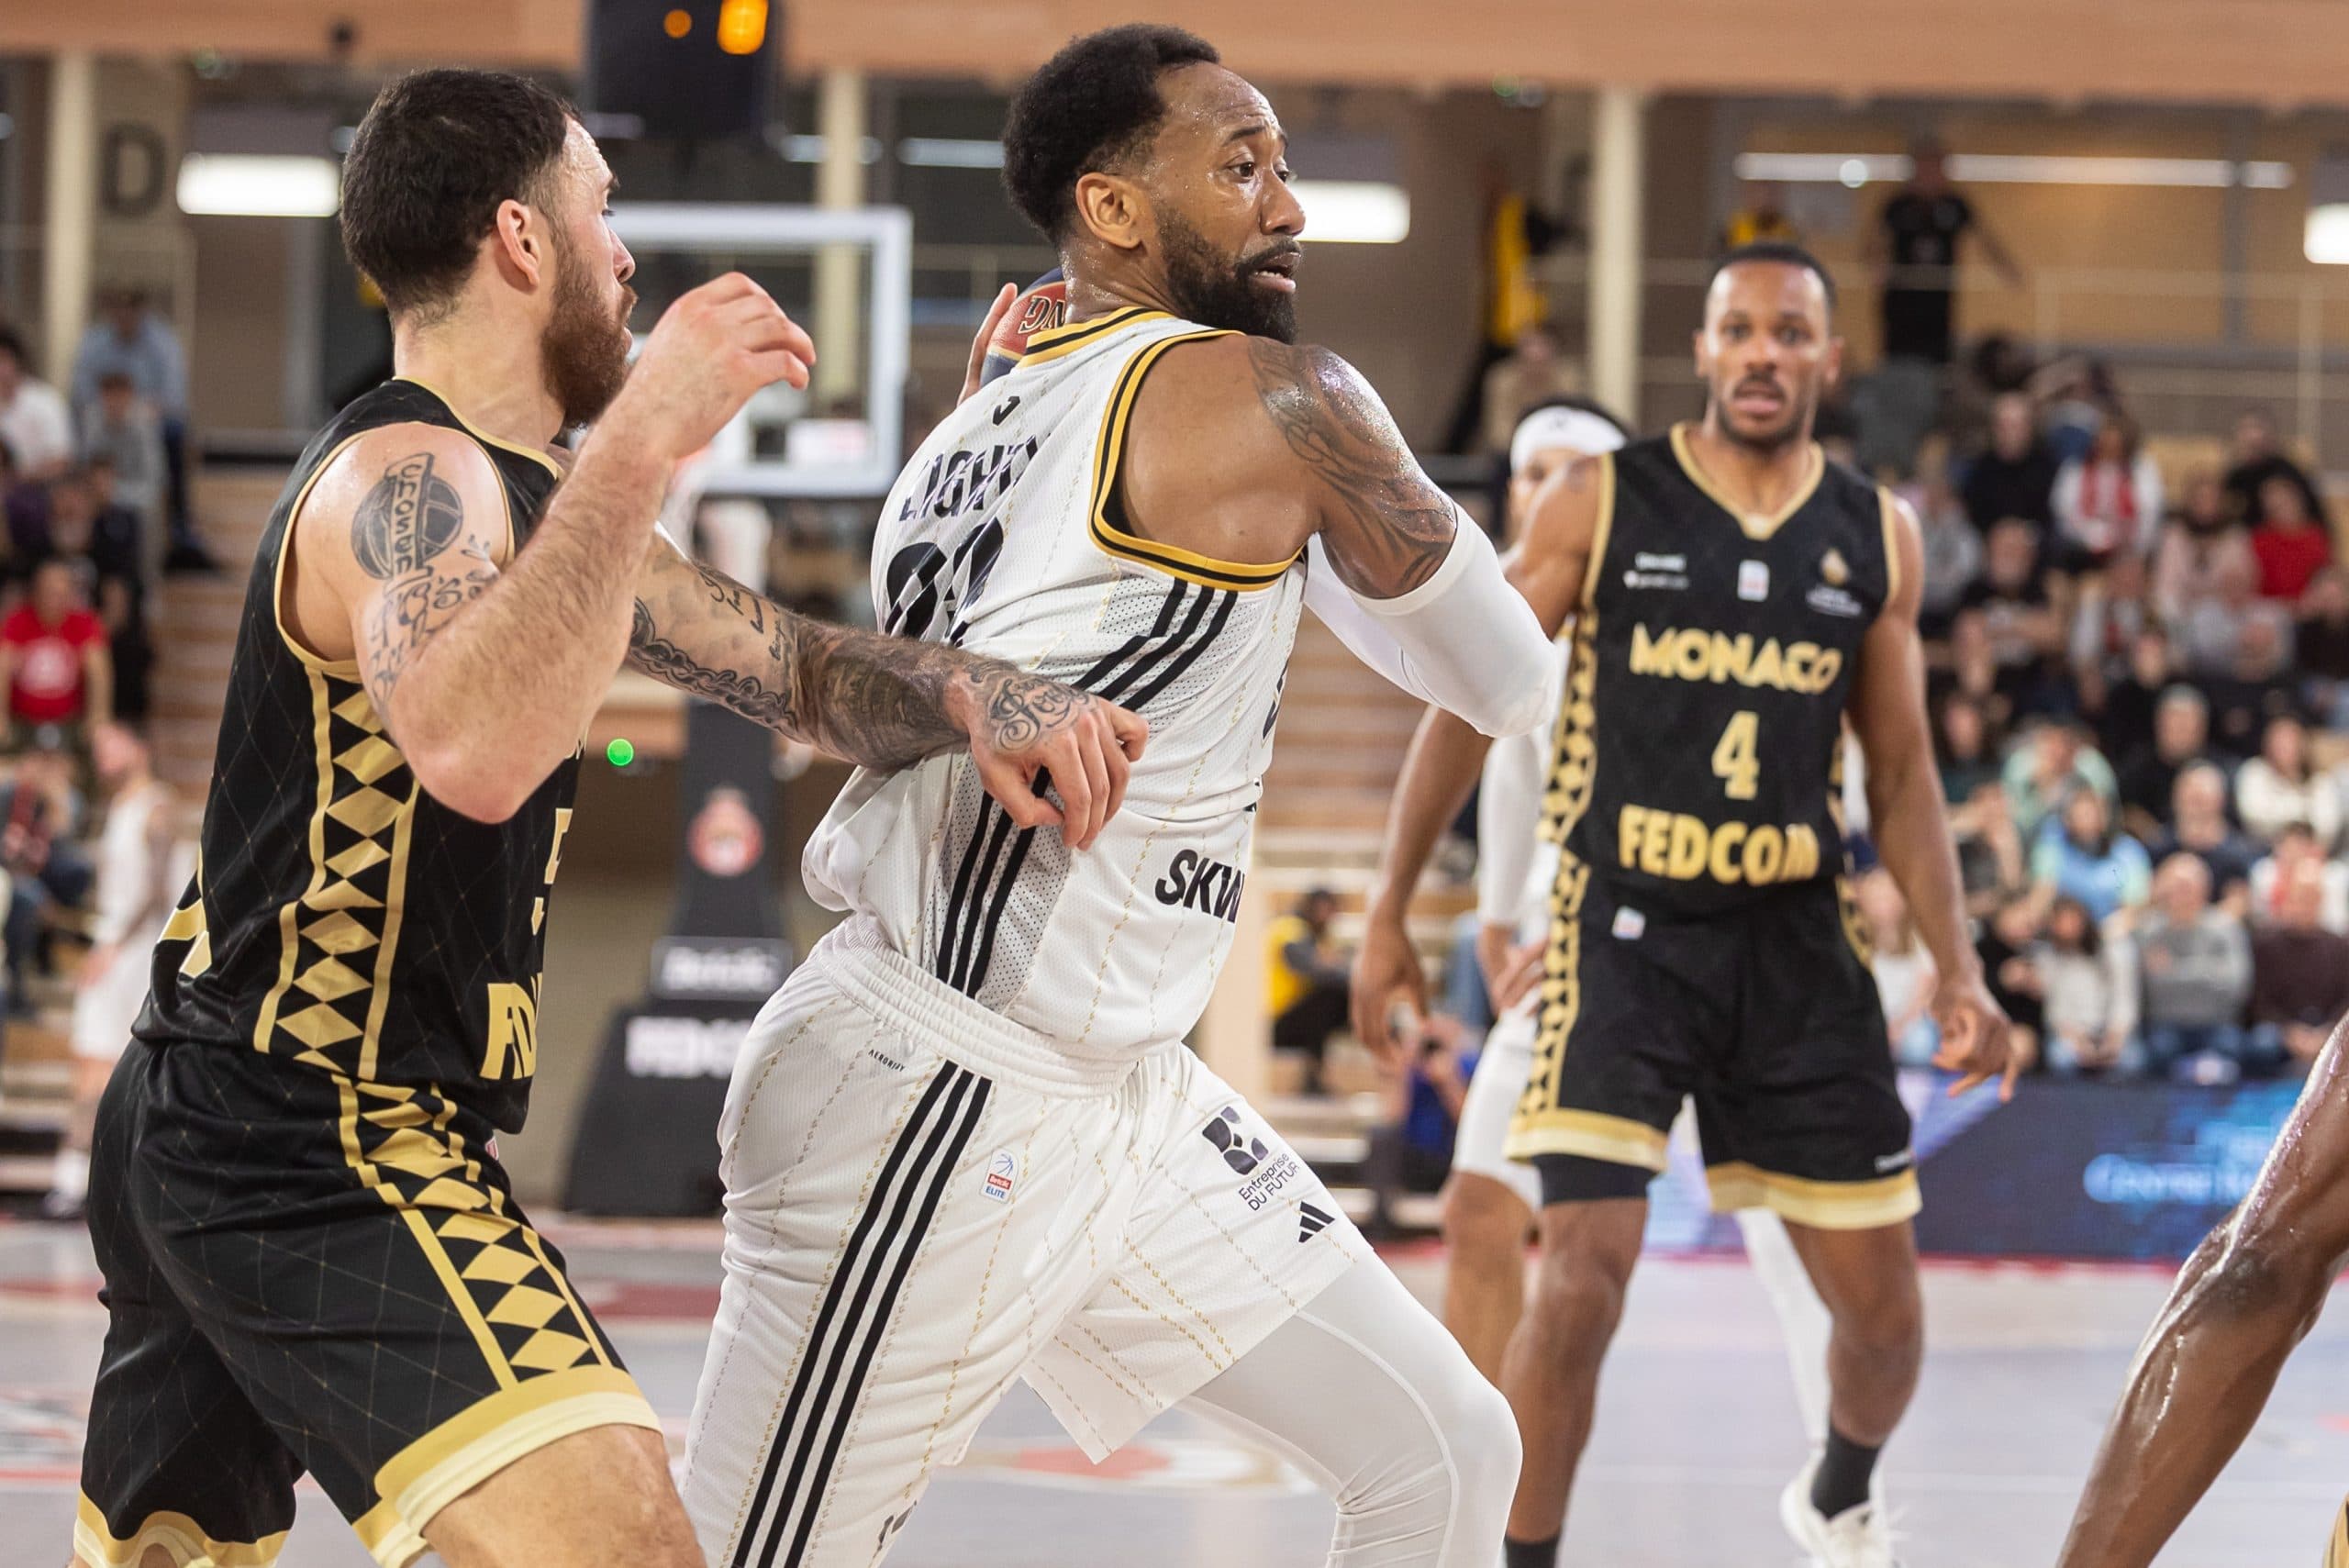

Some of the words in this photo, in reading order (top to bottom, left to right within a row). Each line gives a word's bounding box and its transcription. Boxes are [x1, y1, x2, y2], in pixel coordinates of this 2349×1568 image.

[1630, 621, 1843, 695] MONACO
[1711, 709, 1761, 801] 4
[1618, 803, 1820, 887] FEDCOM
[1154, 849, 1246, 924] SKW
[985, 1185, 1007, 1199] ELITE
[1239, 1153, 1290, 1201] Entreprise
[1248, 1192, 1268, 1211] DU
[1264, 1161, 1300, 1196] FUTUR
